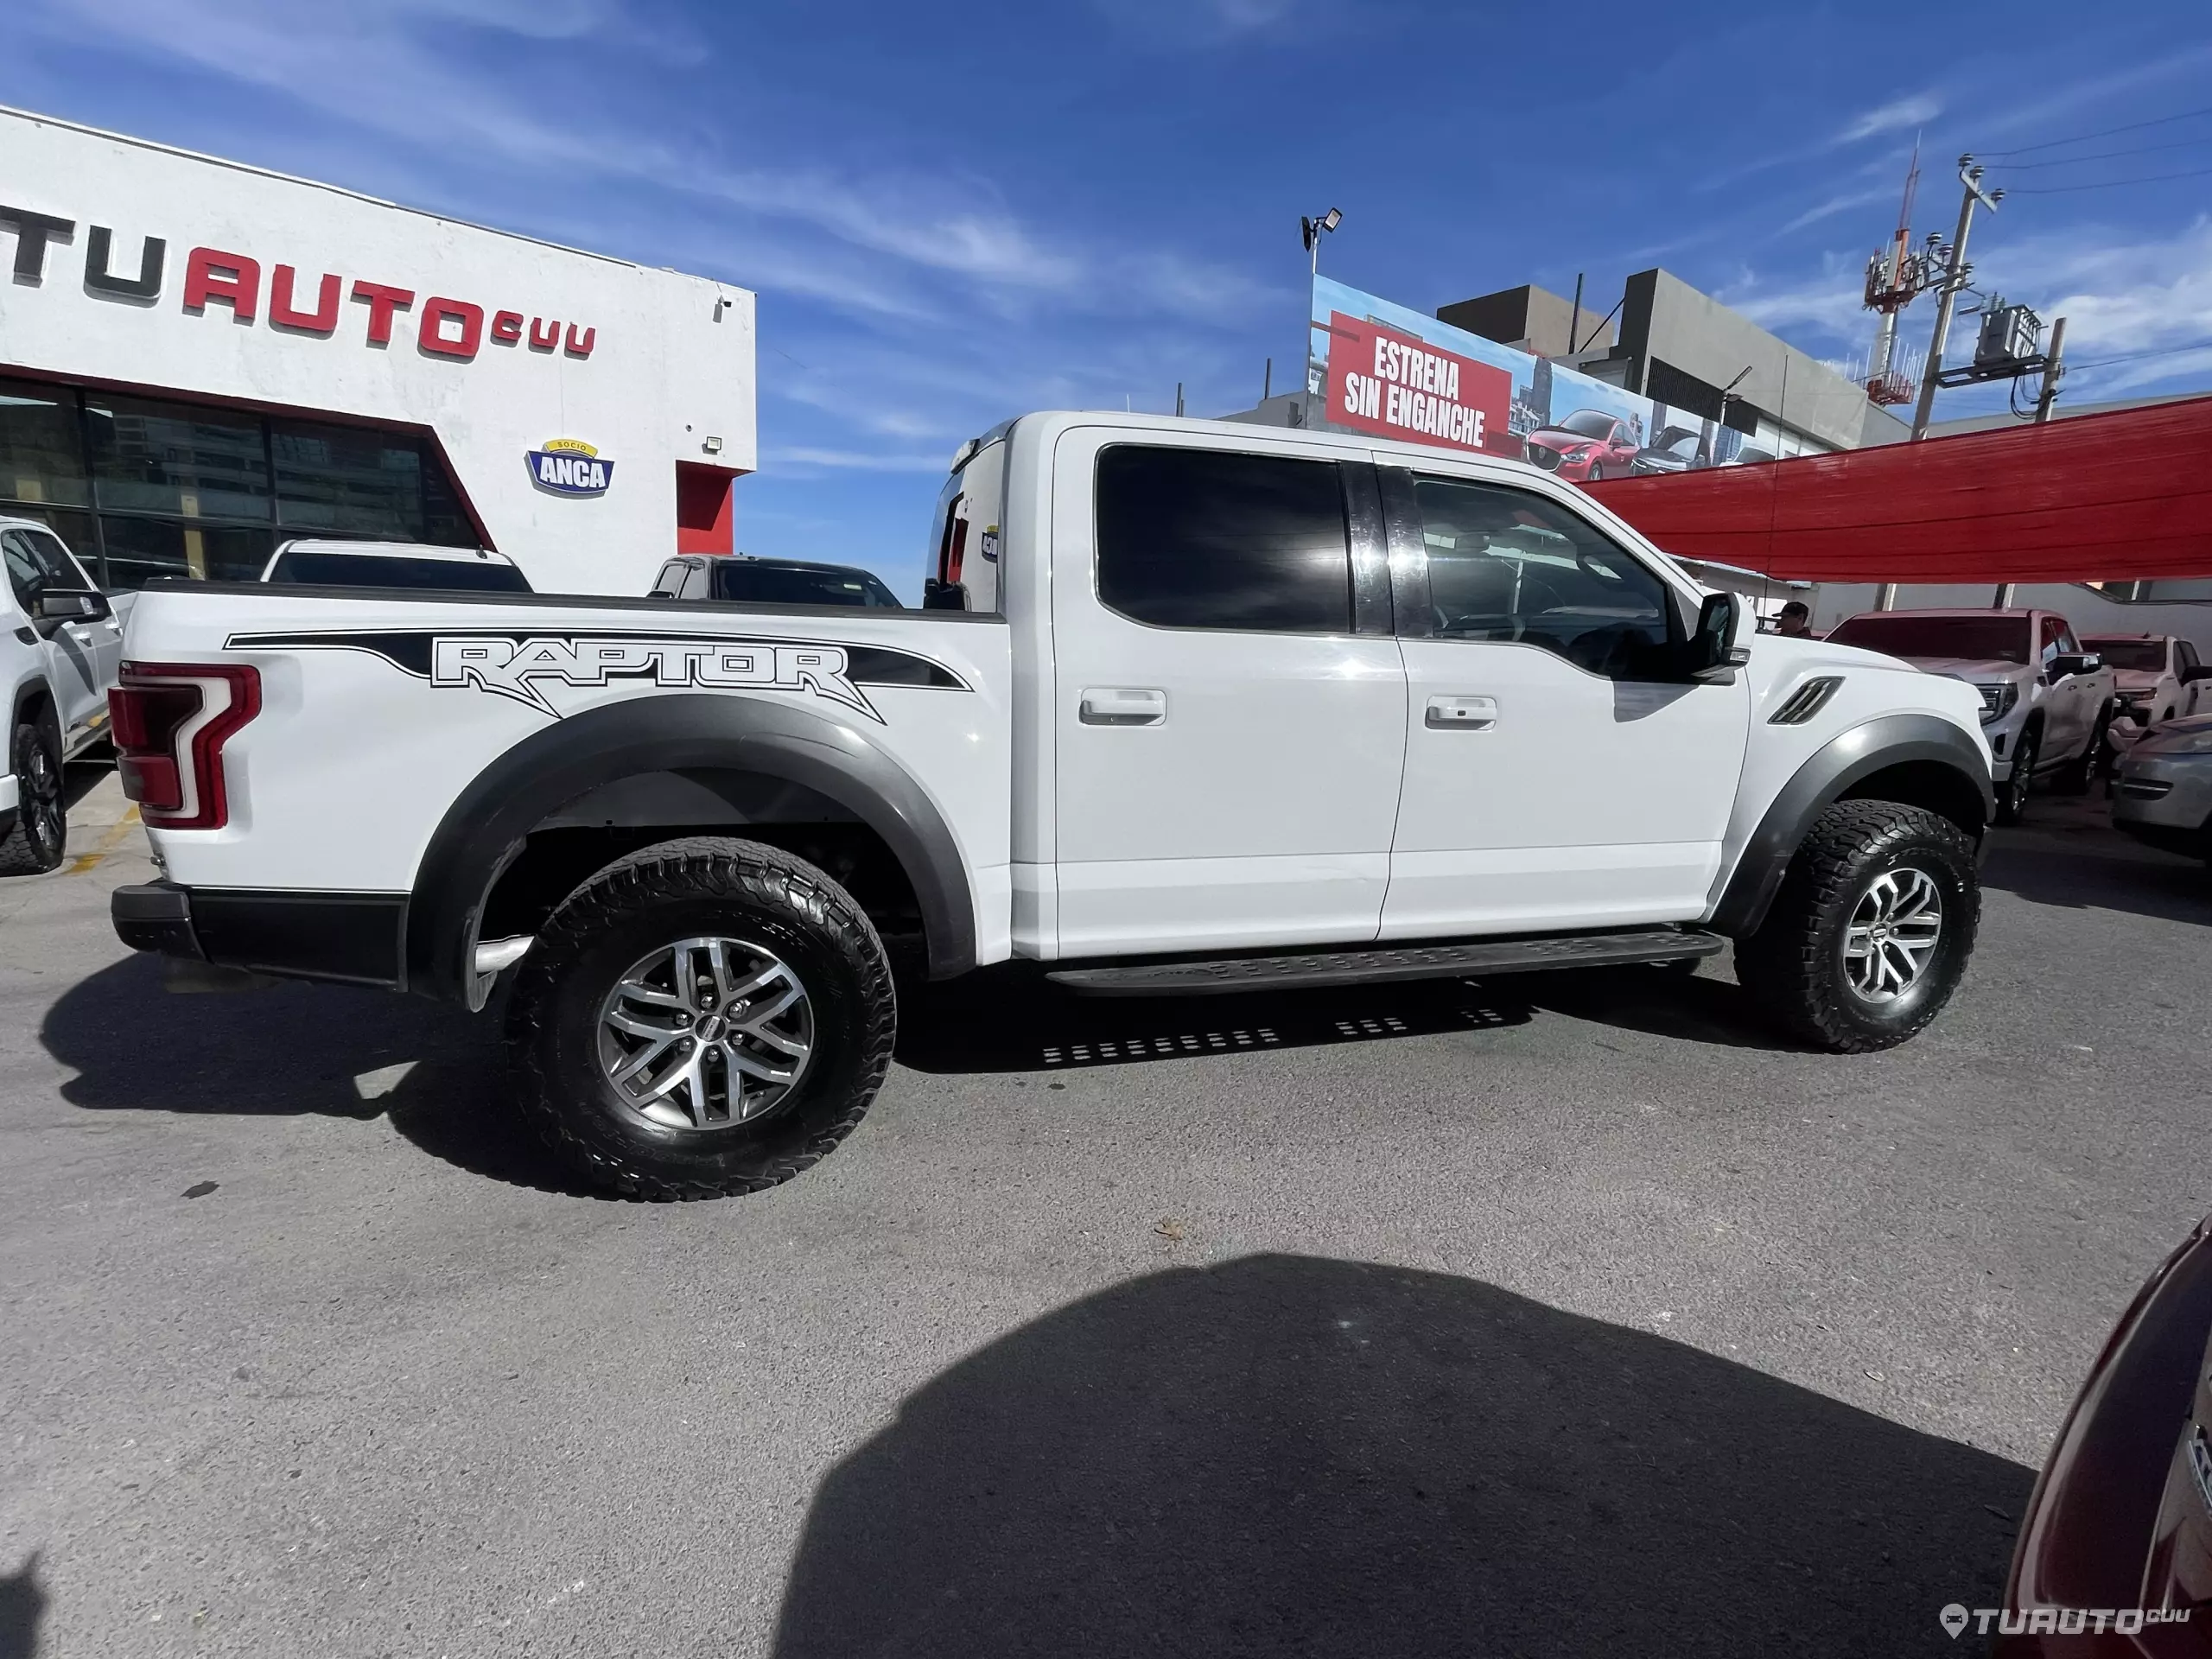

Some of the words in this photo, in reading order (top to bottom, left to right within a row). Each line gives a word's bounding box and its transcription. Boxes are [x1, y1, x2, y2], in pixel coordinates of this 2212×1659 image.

[1374, 335, 1459, 401] ESTRENA
[1344, 372, 1382, 420] SIN
[1386, 383, 1485, 448] ENGANCHE
[540, 456, 606, 488] ANCA
[557, 442, 587, 451] SOCIO
[430, 637, 888, 726] RAPTOR
